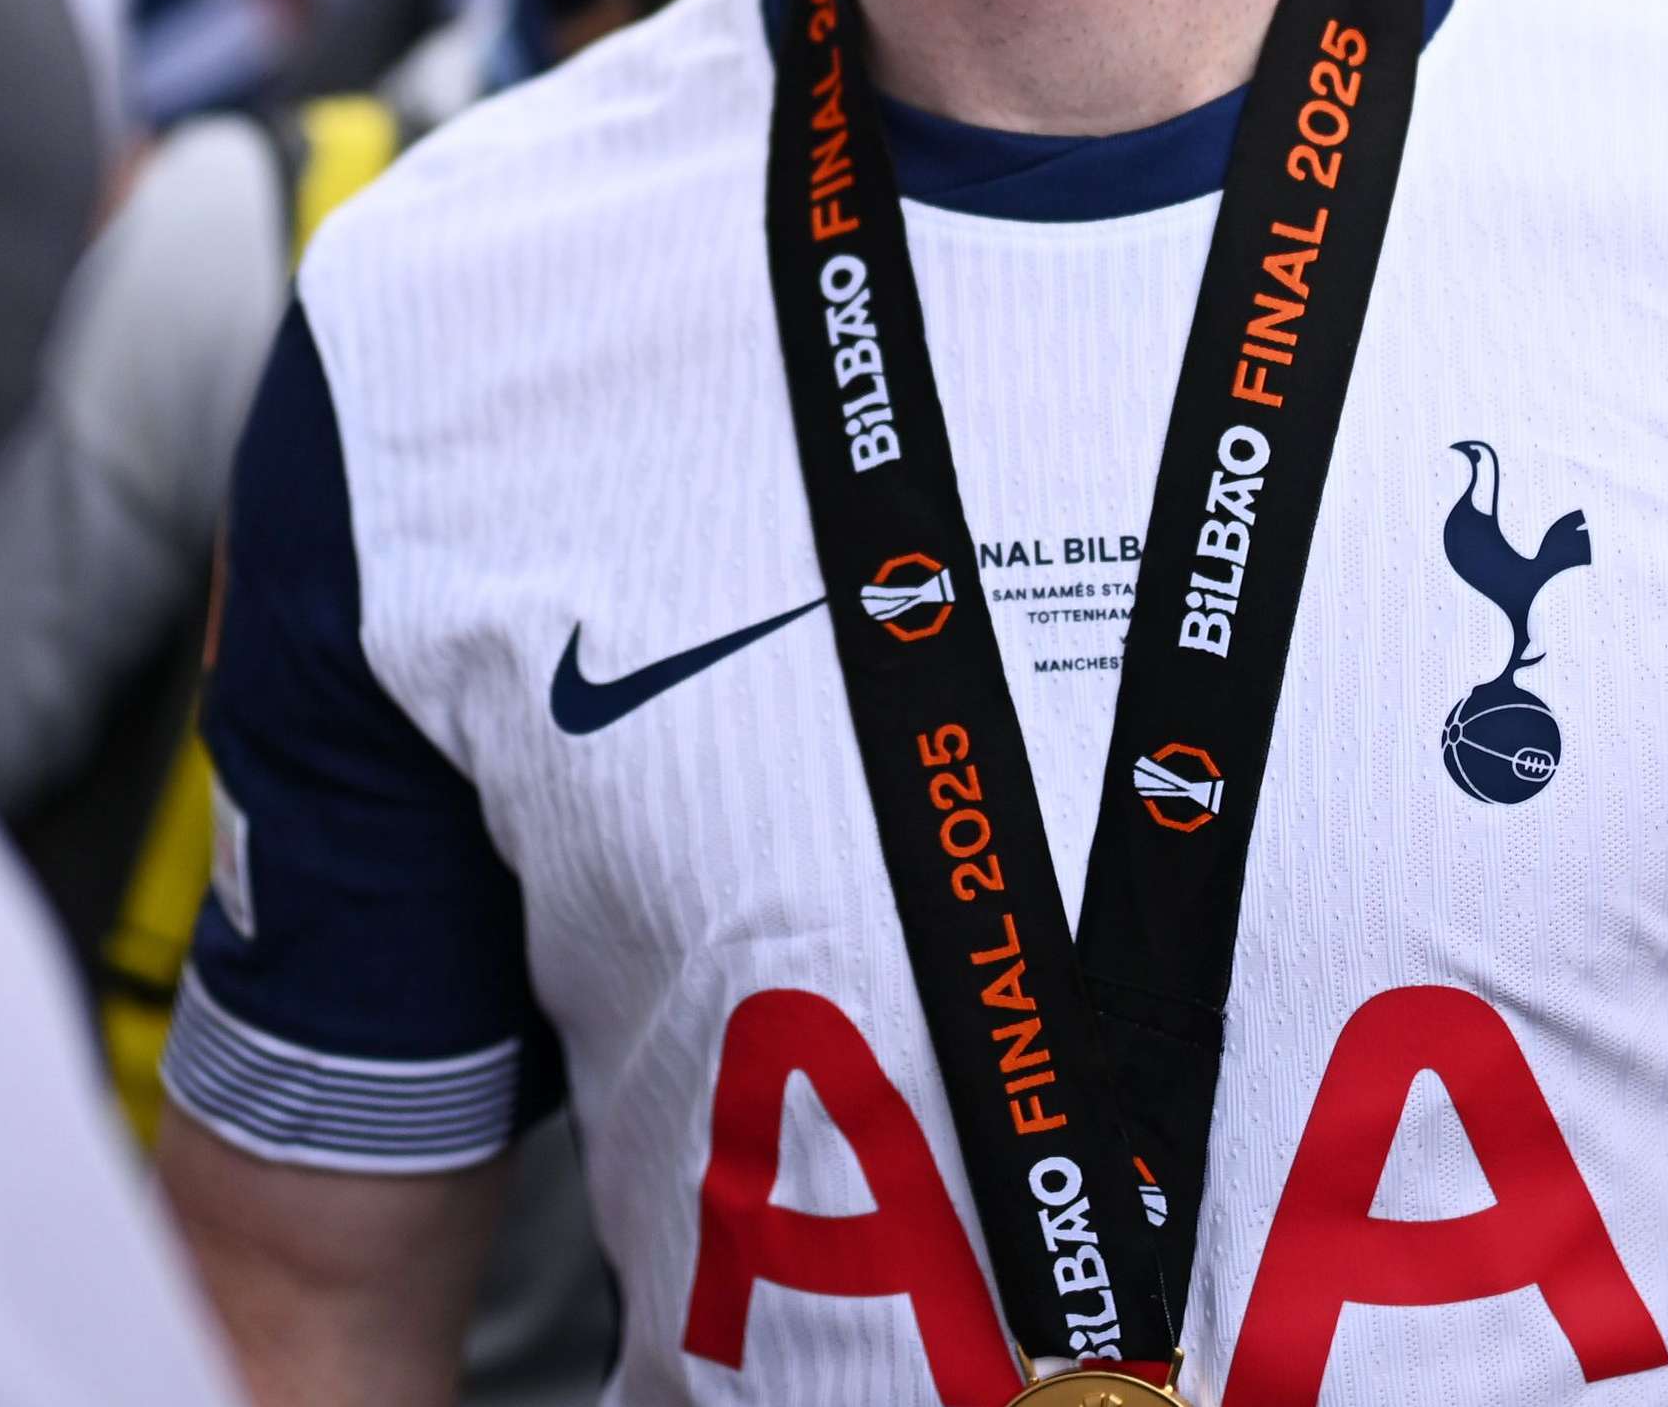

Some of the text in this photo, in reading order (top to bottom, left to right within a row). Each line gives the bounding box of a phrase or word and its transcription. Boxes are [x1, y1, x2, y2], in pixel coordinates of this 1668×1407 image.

[812, 45, 860, 242] FINAL
[1232, 207, 1329, 408] FINAL
[1286, 19, 1368, 189] 2025
[979, 535, 1142, 568] NAL BILB
[992, 581, 1134, 602] SAN MAMÉS STA
[1034, 655, 1124, 673] MANCHES
[918, 723, 1005, 901] 2025
[971, 912, 1068, 1135] FINAL
